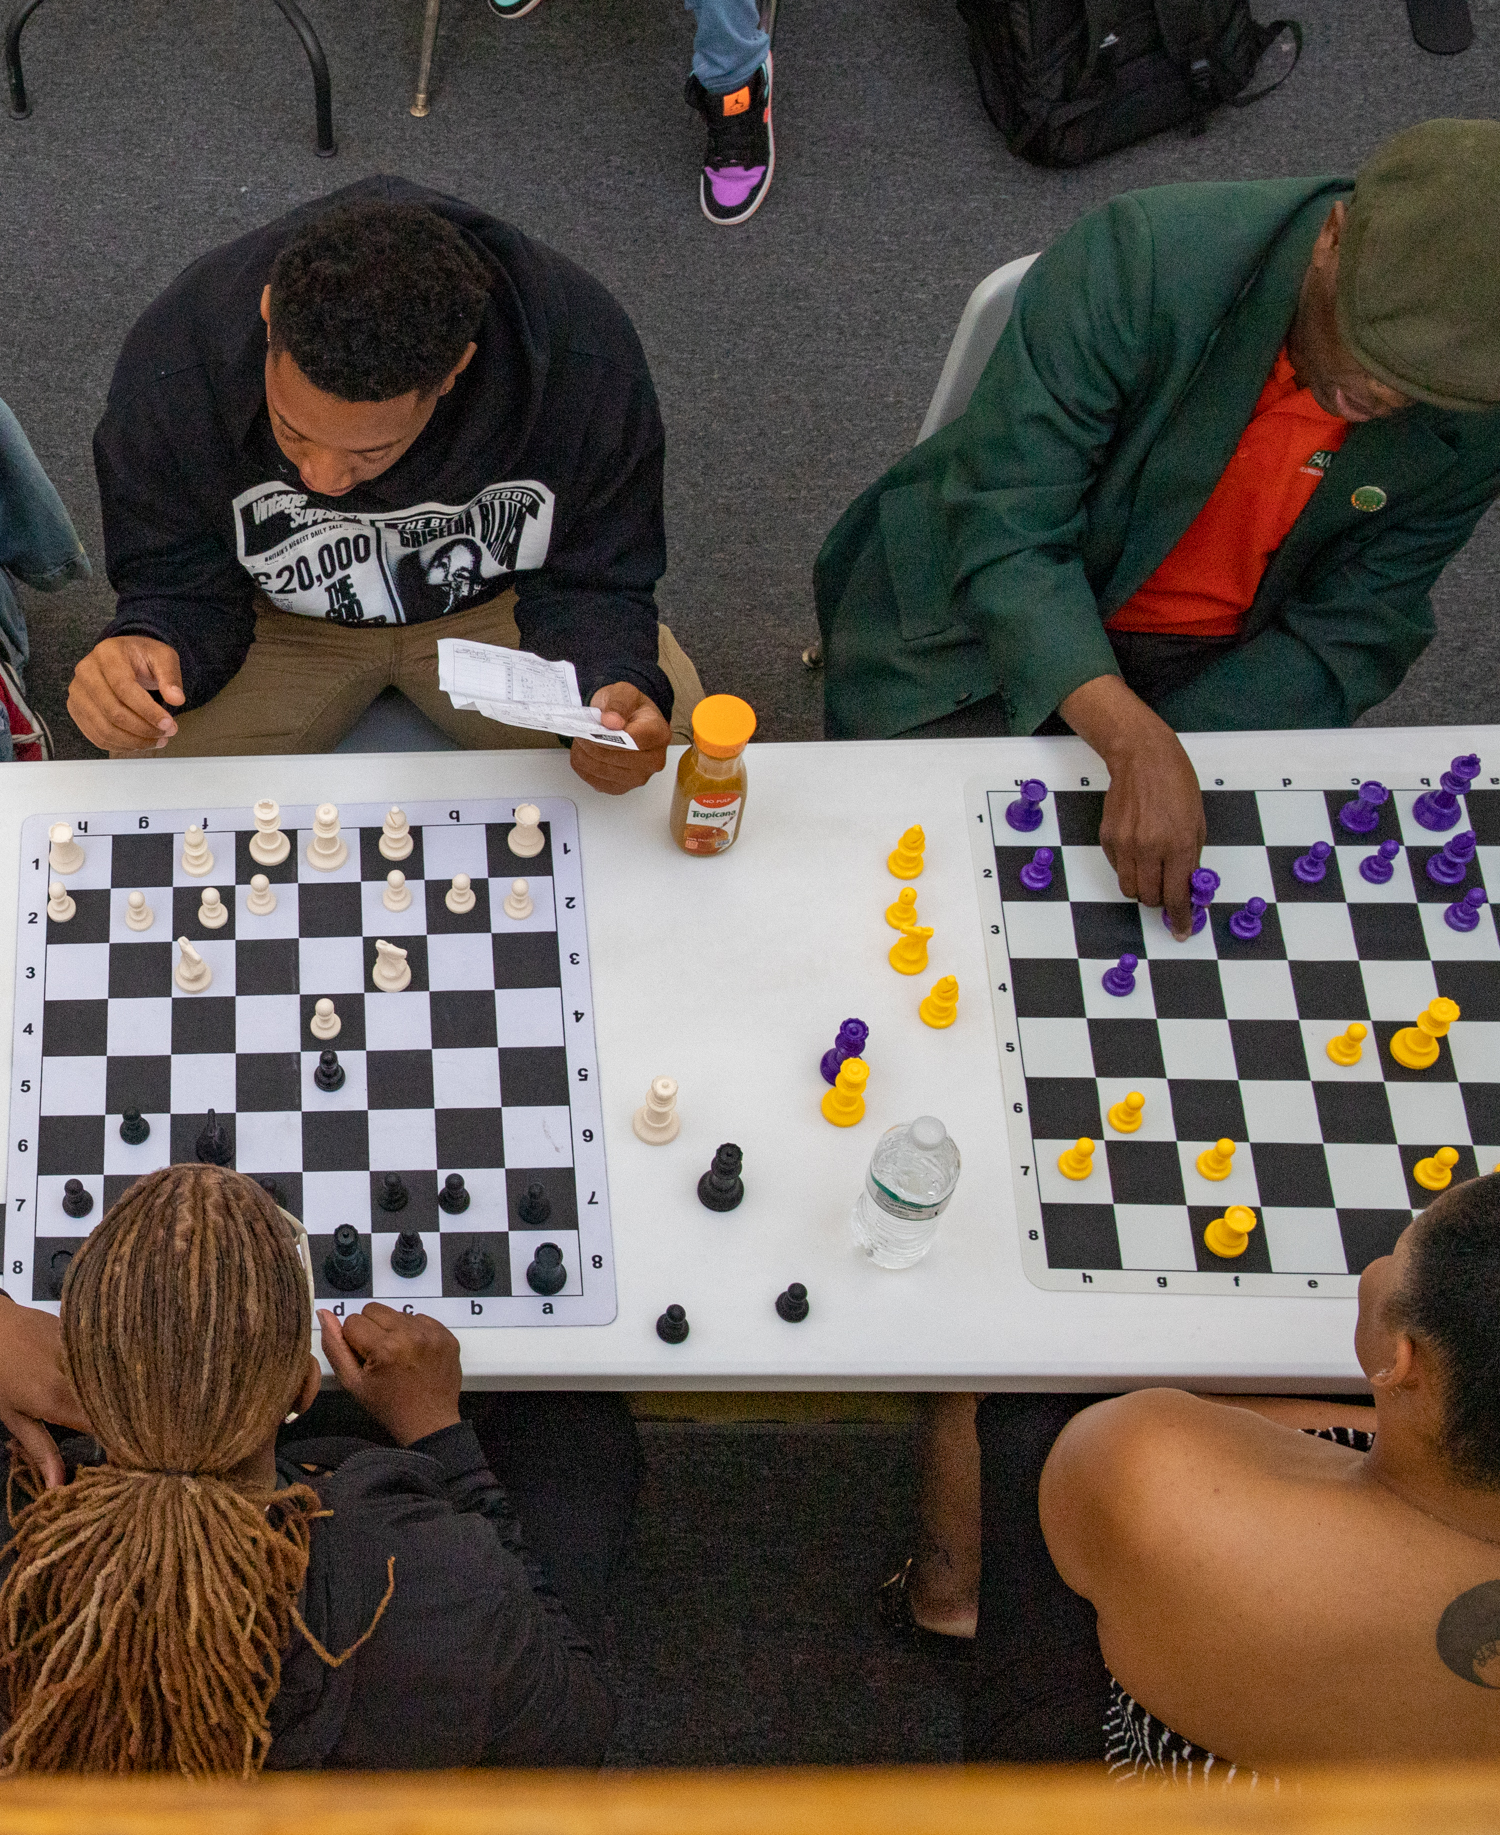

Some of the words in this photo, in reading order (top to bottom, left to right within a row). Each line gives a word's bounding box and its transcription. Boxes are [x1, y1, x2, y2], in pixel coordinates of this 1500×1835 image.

[252, 493, 309, 525] Vintage
[397, 518, 426, 530] THE
[481, 491, 533, 507] WIDOW
[311, 527, 327, 539] DAILY
[253, 534, 371, 594] £20,000
[325, 574, 357, 609] THE
[1081, 777, 1090, 786] g
[1282, 778, 1292, 787] d
[1351, 778, 1360, 786] c
[1420, 778, 1431, 787] b
[78, 821, 88, 833] h
[139, 816, 149, 829] g
[202, 818, 208, 830] f
[449, 810, 460, 822] b
[691, 810, 736, 820] Tropicana
[563, 843, 571, 854] 1
[32, 858, 39, 870] 1
[565, 897, 575, 909] 2
[28, 912, 38, 924] 2
[569, 952, 579, 965] 3
[26, 967, 35, 979] 3
[573, 1010, 584, 1023] 4
[23, 1023, 33, 1035] 4
[977, 814, 983, 823] 1
[983, 869, 992, 878] 2
[991, 925, 1000, 934] 3
[998, 983, 1007, 992] 4
[1006, 1042, 1015, 1052] 5
[1013, 1103, 1023, 1113] 6
[1021, 1166, 1030, 1176] 7
[1029, 1230, 1039, 1240] 8
[578, 1068, 588, 1081] 5
[21, 1080, 31, 1093] 5
[582, 1129, 593, 1142] 6
[18, 1139, 28, 1152] 6
[588, 1191, 598, 1205] 7
[16, 1199, 26, 1212] 7
[13, 1261, 23, 1274] 8
[592, 1255, 602, 1269] 8
[1082, 1273, 1093, 1283] h
[1157, 1277, 1167, 1288] g
[1233, 1276, 1240, 1287] f
[1307, 1280, 1318, 1288] e
[333, 1302, 344, 1316] d
[401, 1304, 411, 1315] c
[471, 1300, 483, 1315] b
[542, 1303, 553, 1314] a
